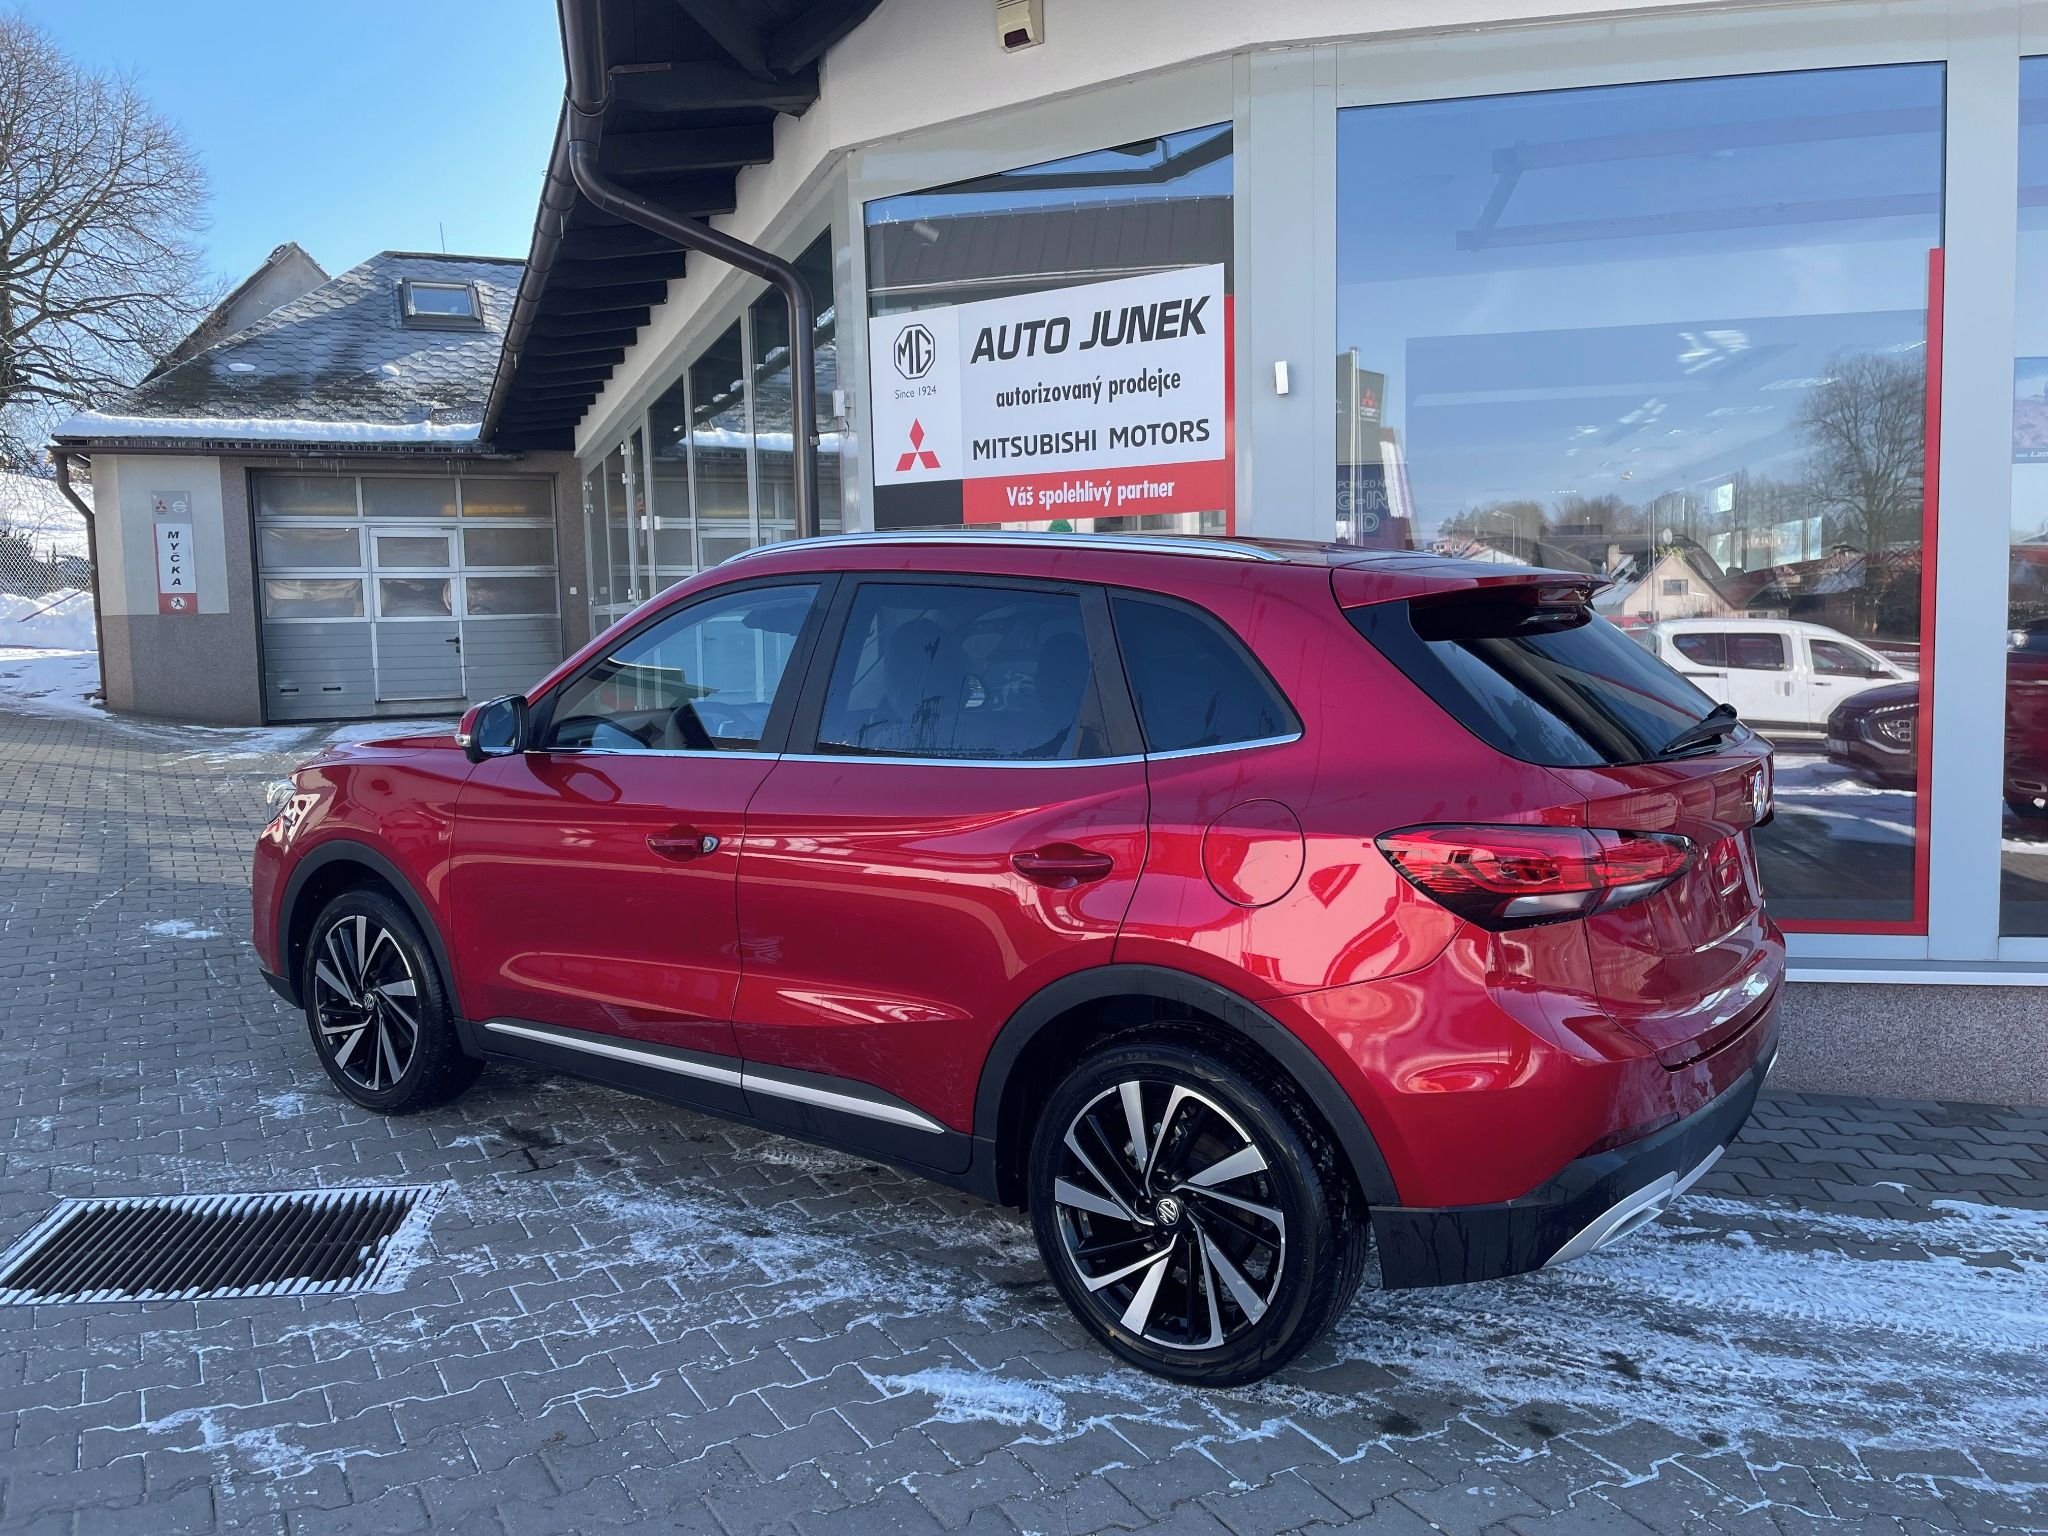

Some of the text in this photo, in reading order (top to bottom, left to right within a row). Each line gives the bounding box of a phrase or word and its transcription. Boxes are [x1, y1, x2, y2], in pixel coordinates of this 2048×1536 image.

[970, 296, 1211, 364] AUTO JUNEK
[896, 327, 933, 377] MG
[894, 385, 937, 400] Since 1924
[996, 368, 1181, 408] autorizovaný prodejce
[973, 419, 1210, 461] MITSUBISHI MOTORS
[1006, 480, 1175, 510] Váš spolehlivý partner
[167, 531, 182, 586] MYČKA
